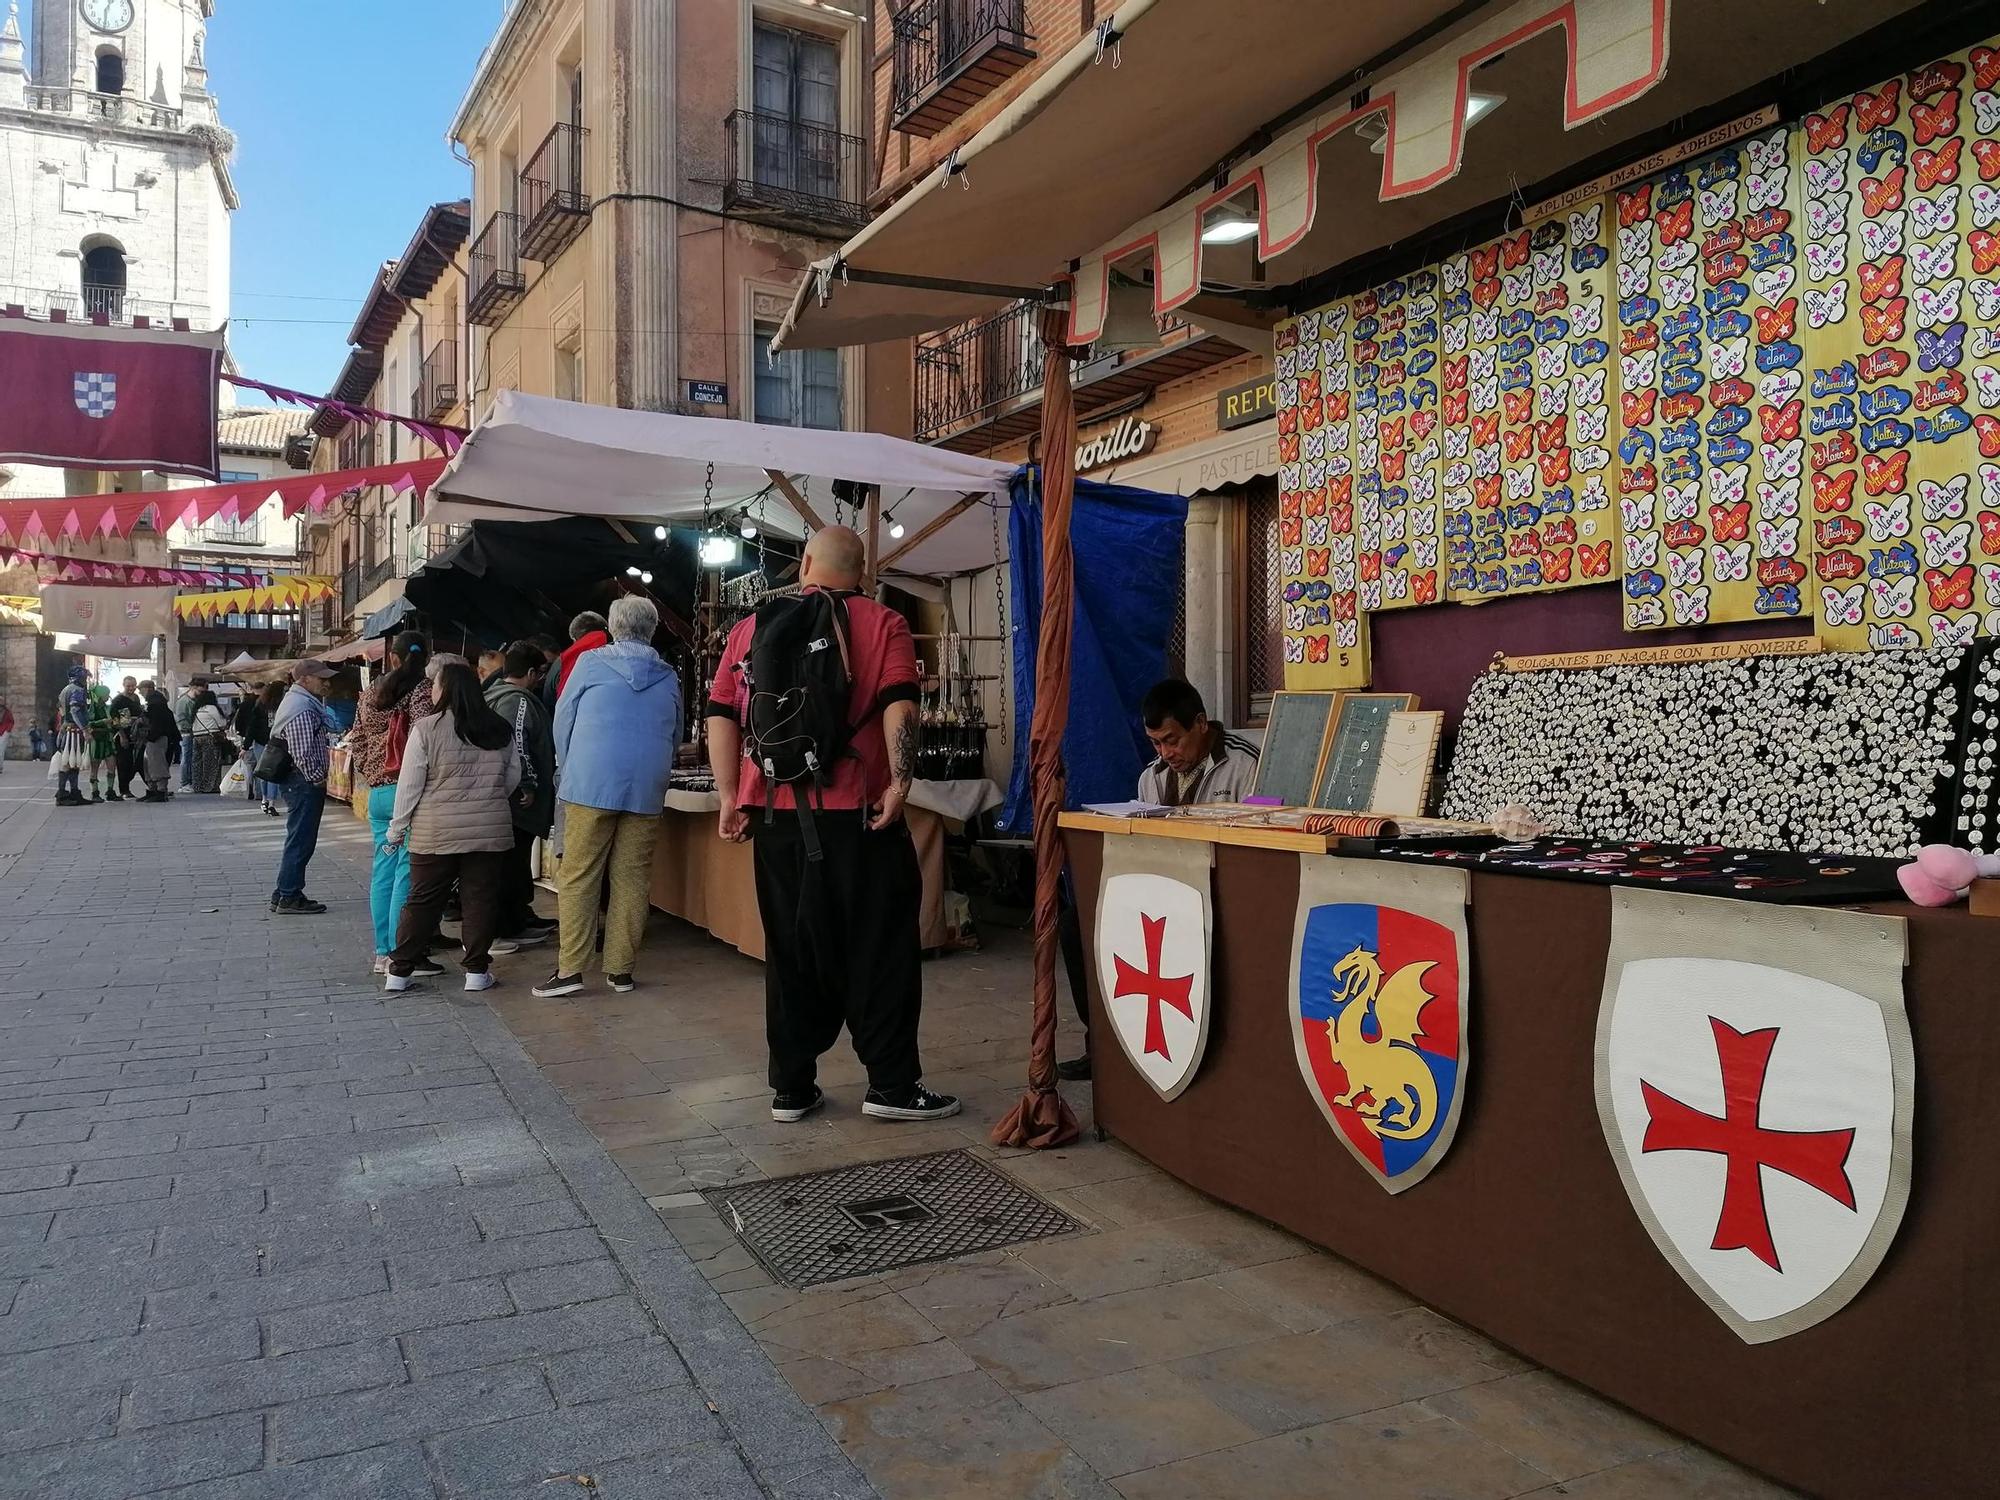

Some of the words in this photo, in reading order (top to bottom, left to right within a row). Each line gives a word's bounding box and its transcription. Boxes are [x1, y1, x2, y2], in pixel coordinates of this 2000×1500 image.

[1675, 113, 1763, 158] ADHESIVOS
[1919, 147, 1957, 188] Marina
[1751, 180, 1781, 208] Irene
[1916, 193, 1957, 236] Martina
[1581, 279, 1592, 297] 5
[1577, 308, 1598, 332] Diana
[1766, 345, 1790, 365] Jon
[694, 392, 723, 403] CONCEJO
[698, 384, 719, 392] CALLE
[1761, 377, 1799, 398] Lourdes
[1916, 385, 1961, 406] Marcos
[1762, 404, 1798, 441] Leonor
[1407, 438, 1416, 452] 5
[1766, 448, 1799, 478] Laura
[1712, 476, 1741, 499] Lara
[1763, 490, 1795, 517] Leyre
[1927, 485, 1964, 520] Natalia
[1875, 508, 1903, 538] Nora
[1931, 534, 1964, 565] Nerea
[1764, 562, 1796, 581] Luca
[1880, 592, 1907, 615] Noa
[1340, 652, 1350, 667] 5
[1517, 654, 1589, 670] COLGANTES
[1595, 653, 1612, 665] DE
[1674, 646, 1703, 660] CON
[1711, 645, 1730, 658] TU
[1738, 638, 1809, 655] NOMBRE
